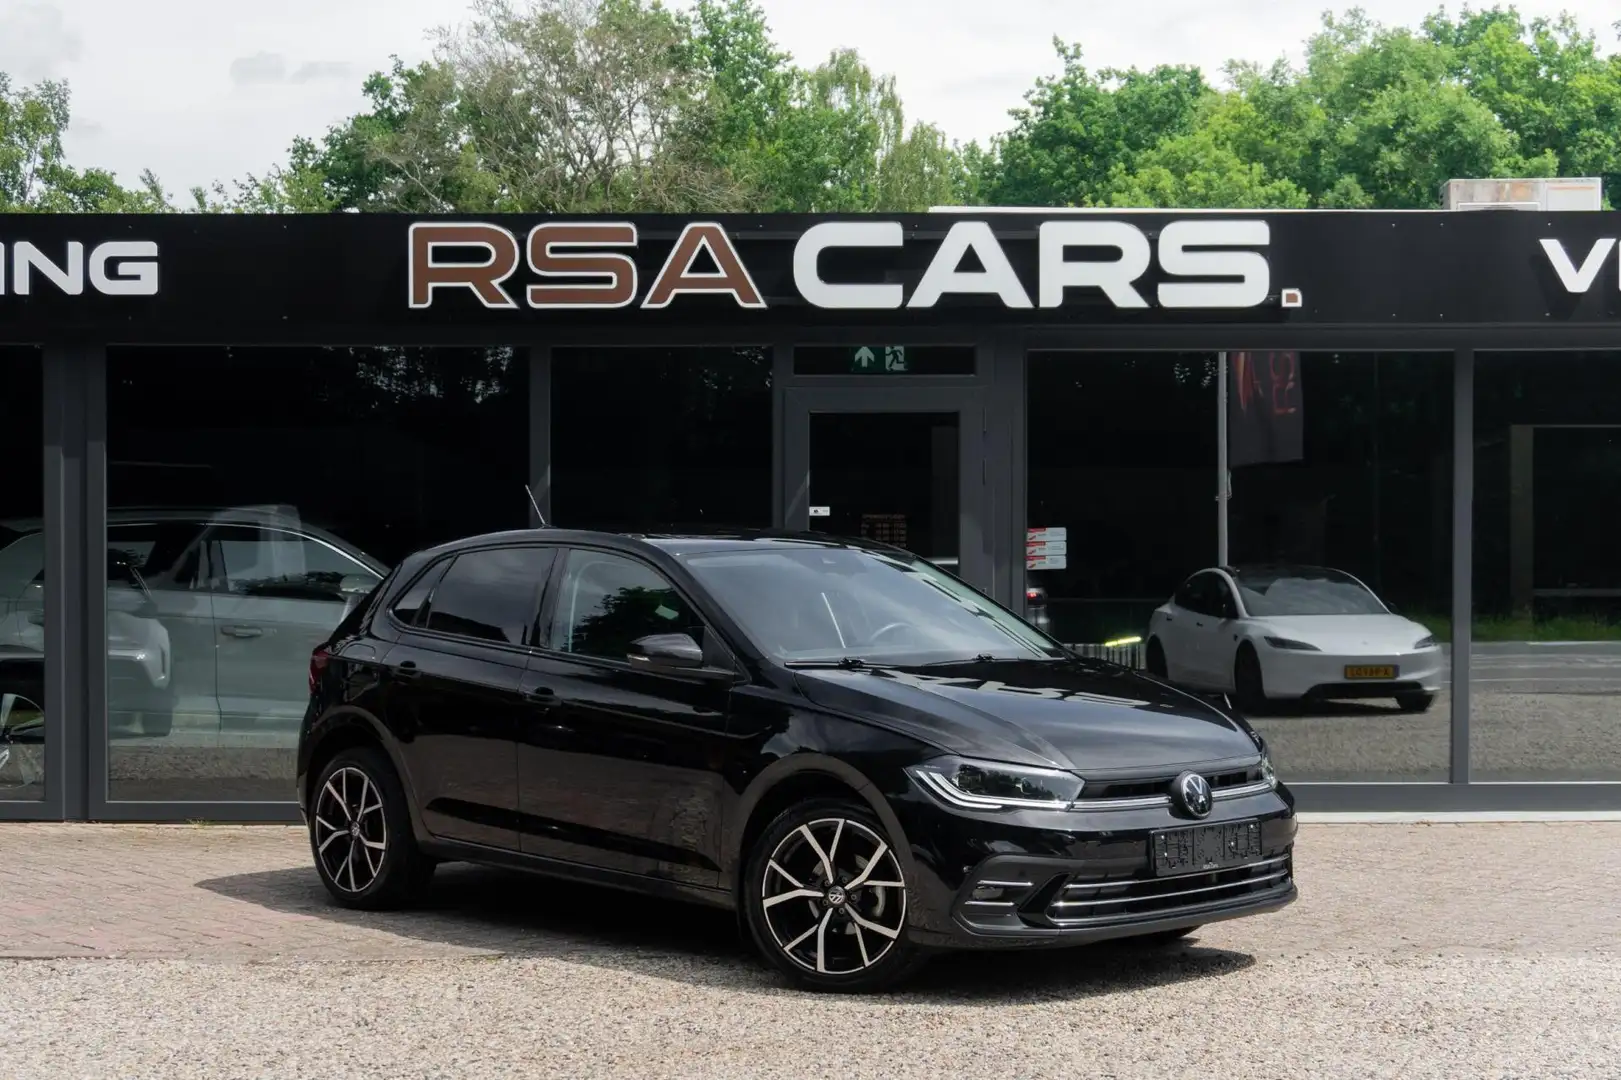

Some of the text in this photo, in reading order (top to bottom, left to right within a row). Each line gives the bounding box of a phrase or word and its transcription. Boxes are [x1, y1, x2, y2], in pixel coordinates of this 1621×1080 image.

[0, 241, 159, 295] NG
[408, 220, 1303, 309] RSA CARS.
[1538, 237, 1621, 293] V
